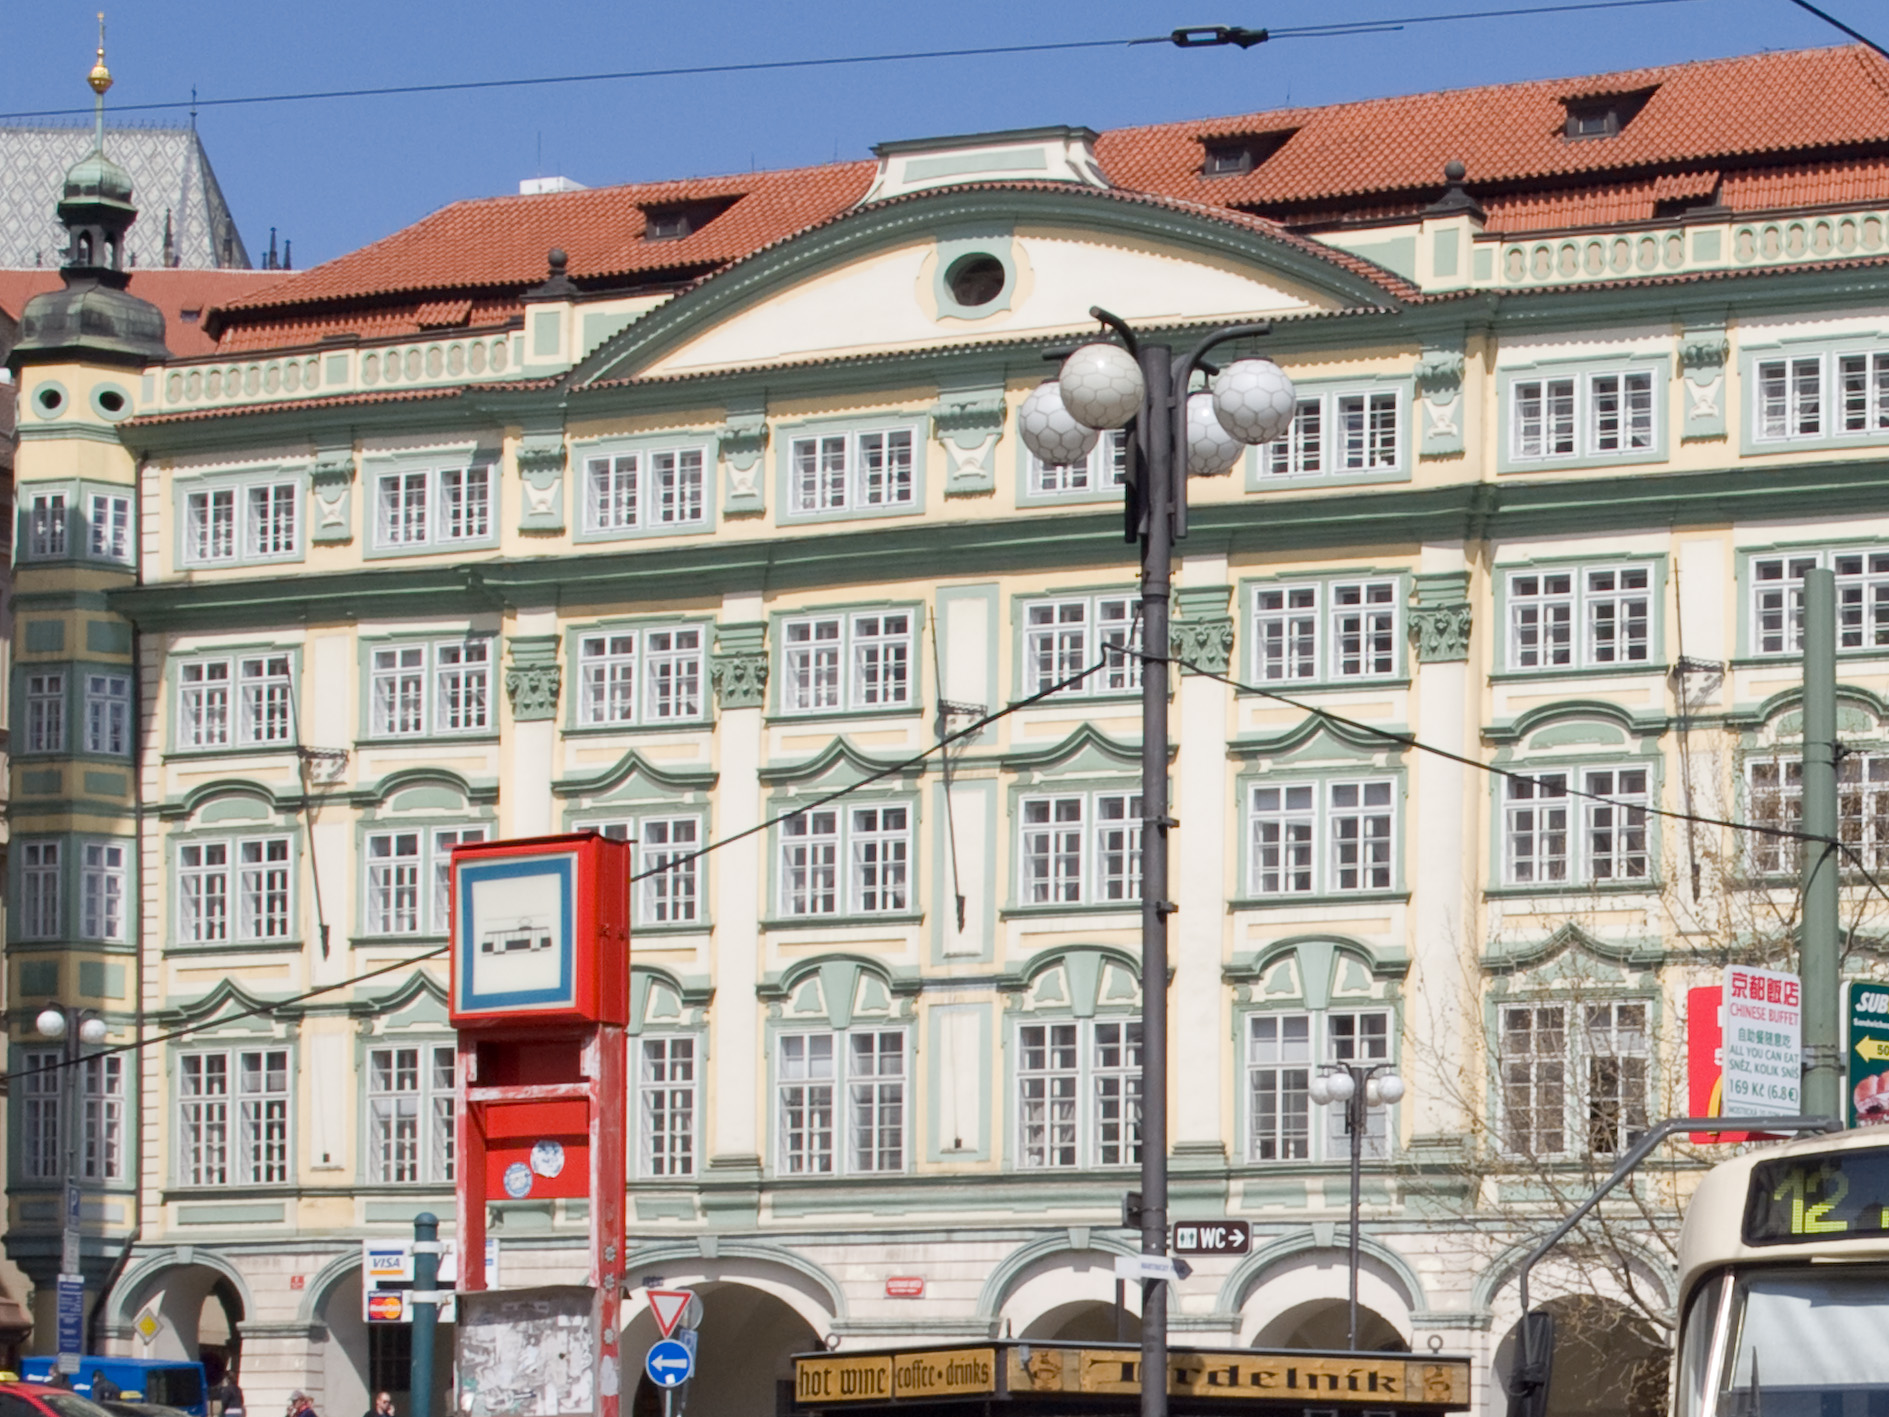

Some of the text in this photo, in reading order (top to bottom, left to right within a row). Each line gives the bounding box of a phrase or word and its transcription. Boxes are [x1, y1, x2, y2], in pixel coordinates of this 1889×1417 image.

[1730, 1002, 1799, 1026] CHINESE BUFFET
[1730, 1044, 1799, 1064] ALL YOU CAN EAT
[1754, 1063, 1779, 1077] KOLIK
[1730, 1079, 1749, 1096] 169
[1751, 1082, 1765, 1098] Kč
[1774, 1164, 1849, 1234] 12
[1200, 1227, 1226, 1250] WC
[372, 1257, 401, 1268] VISA
[800, 1364, 886, 1397] hot wine
[897, 1357, 989, 1389] coffee drinks
